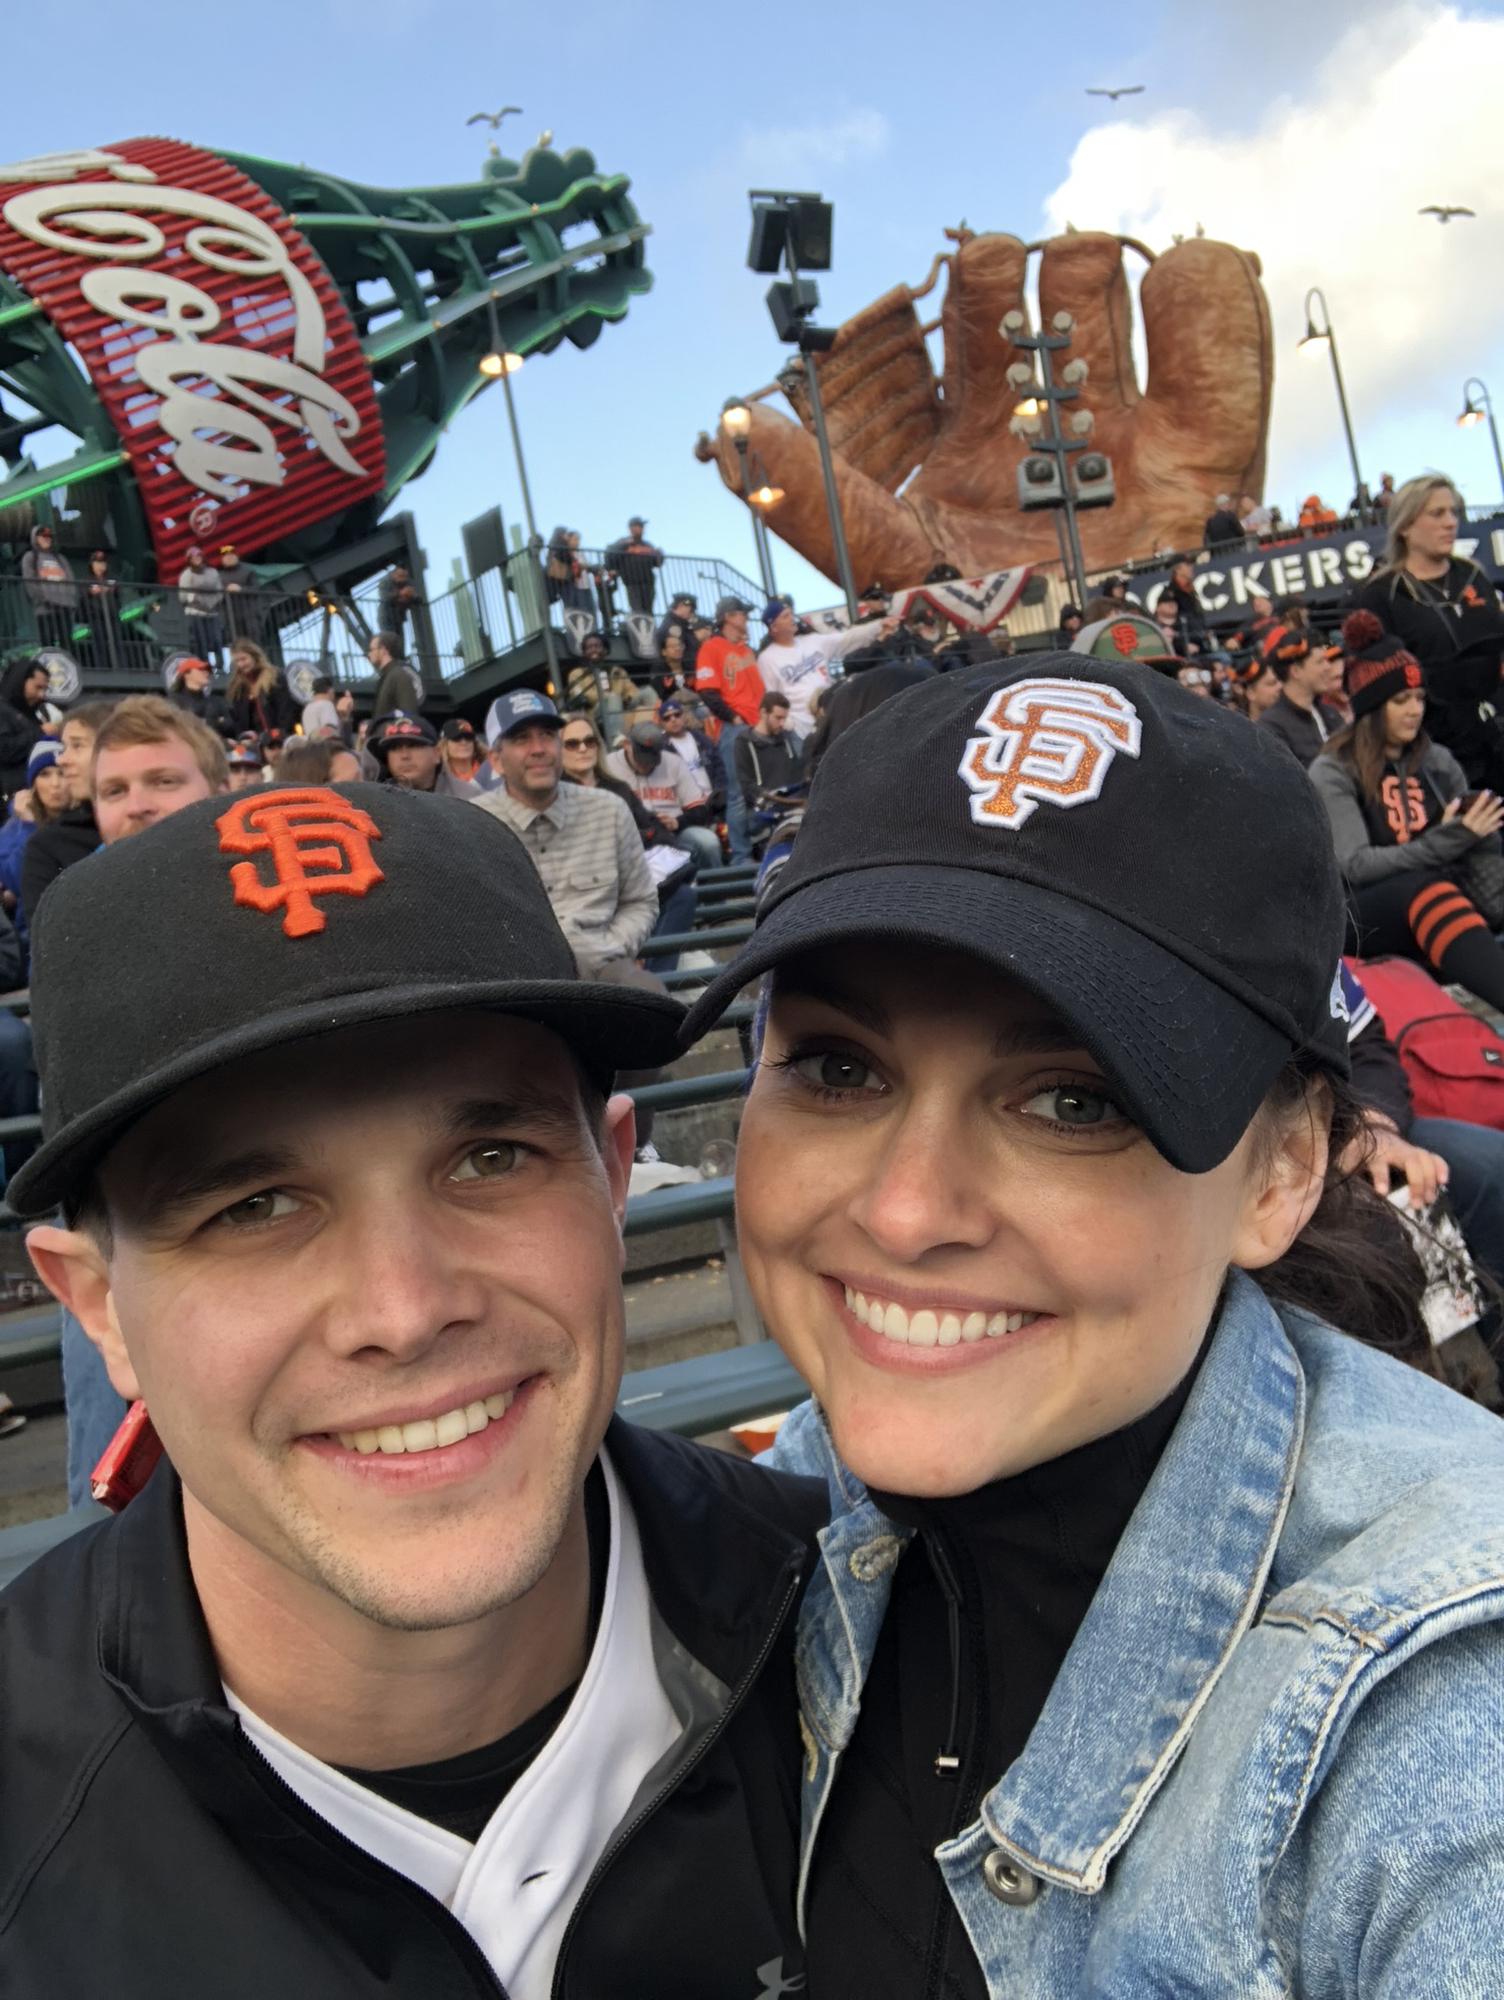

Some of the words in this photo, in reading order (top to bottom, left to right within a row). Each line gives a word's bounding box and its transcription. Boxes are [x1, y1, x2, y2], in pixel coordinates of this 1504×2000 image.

[1125, 541, 1375, 612] CKERS
[958, 677, 1143, 832] SF
[214, 787, 385, 939] SF
